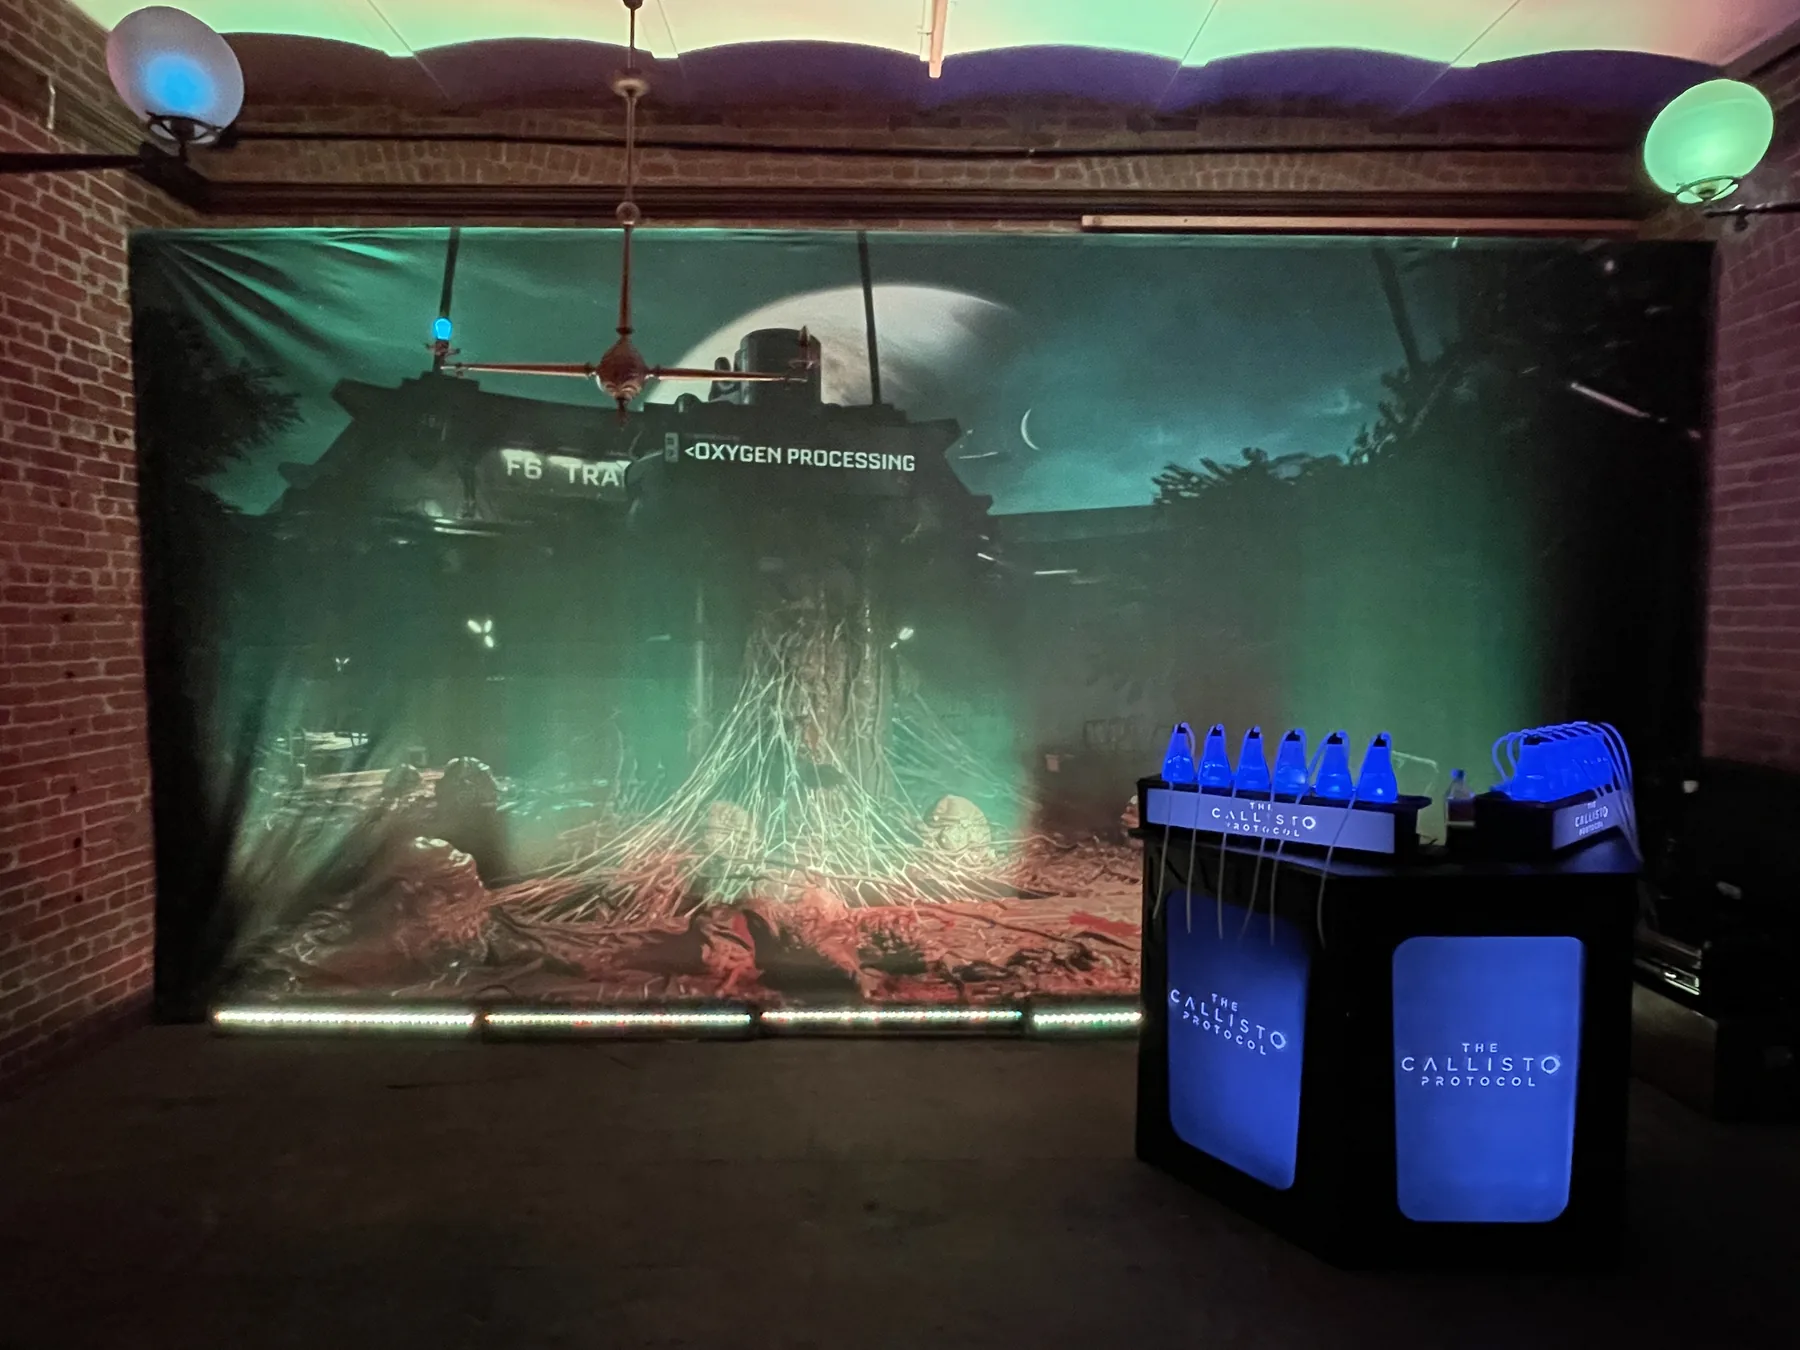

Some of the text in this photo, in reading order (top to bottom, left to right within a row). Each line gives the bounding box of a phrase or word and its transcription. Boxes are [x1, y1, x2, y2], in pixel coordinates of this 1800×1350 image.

[787, 448, 916, 472] PROCESSING
[505, 456, 628, 488] F6 TRA
[1211, 807, 1316, 830] CALLSTO
[1575, 806, 1609, 828] CALLISTO
[1211, 993, 1238, 1012] THE
[1170, 989, 1287, 1050] CALLISTO
[1182, 1011, 1267, 1056] PROTOCOL
[1461, 1042, 1499, 1053] THE
[1401, 1055, 1561, 1075] CALLISTO
[1421, 1076, 1536, 1087] PROTOCOL
